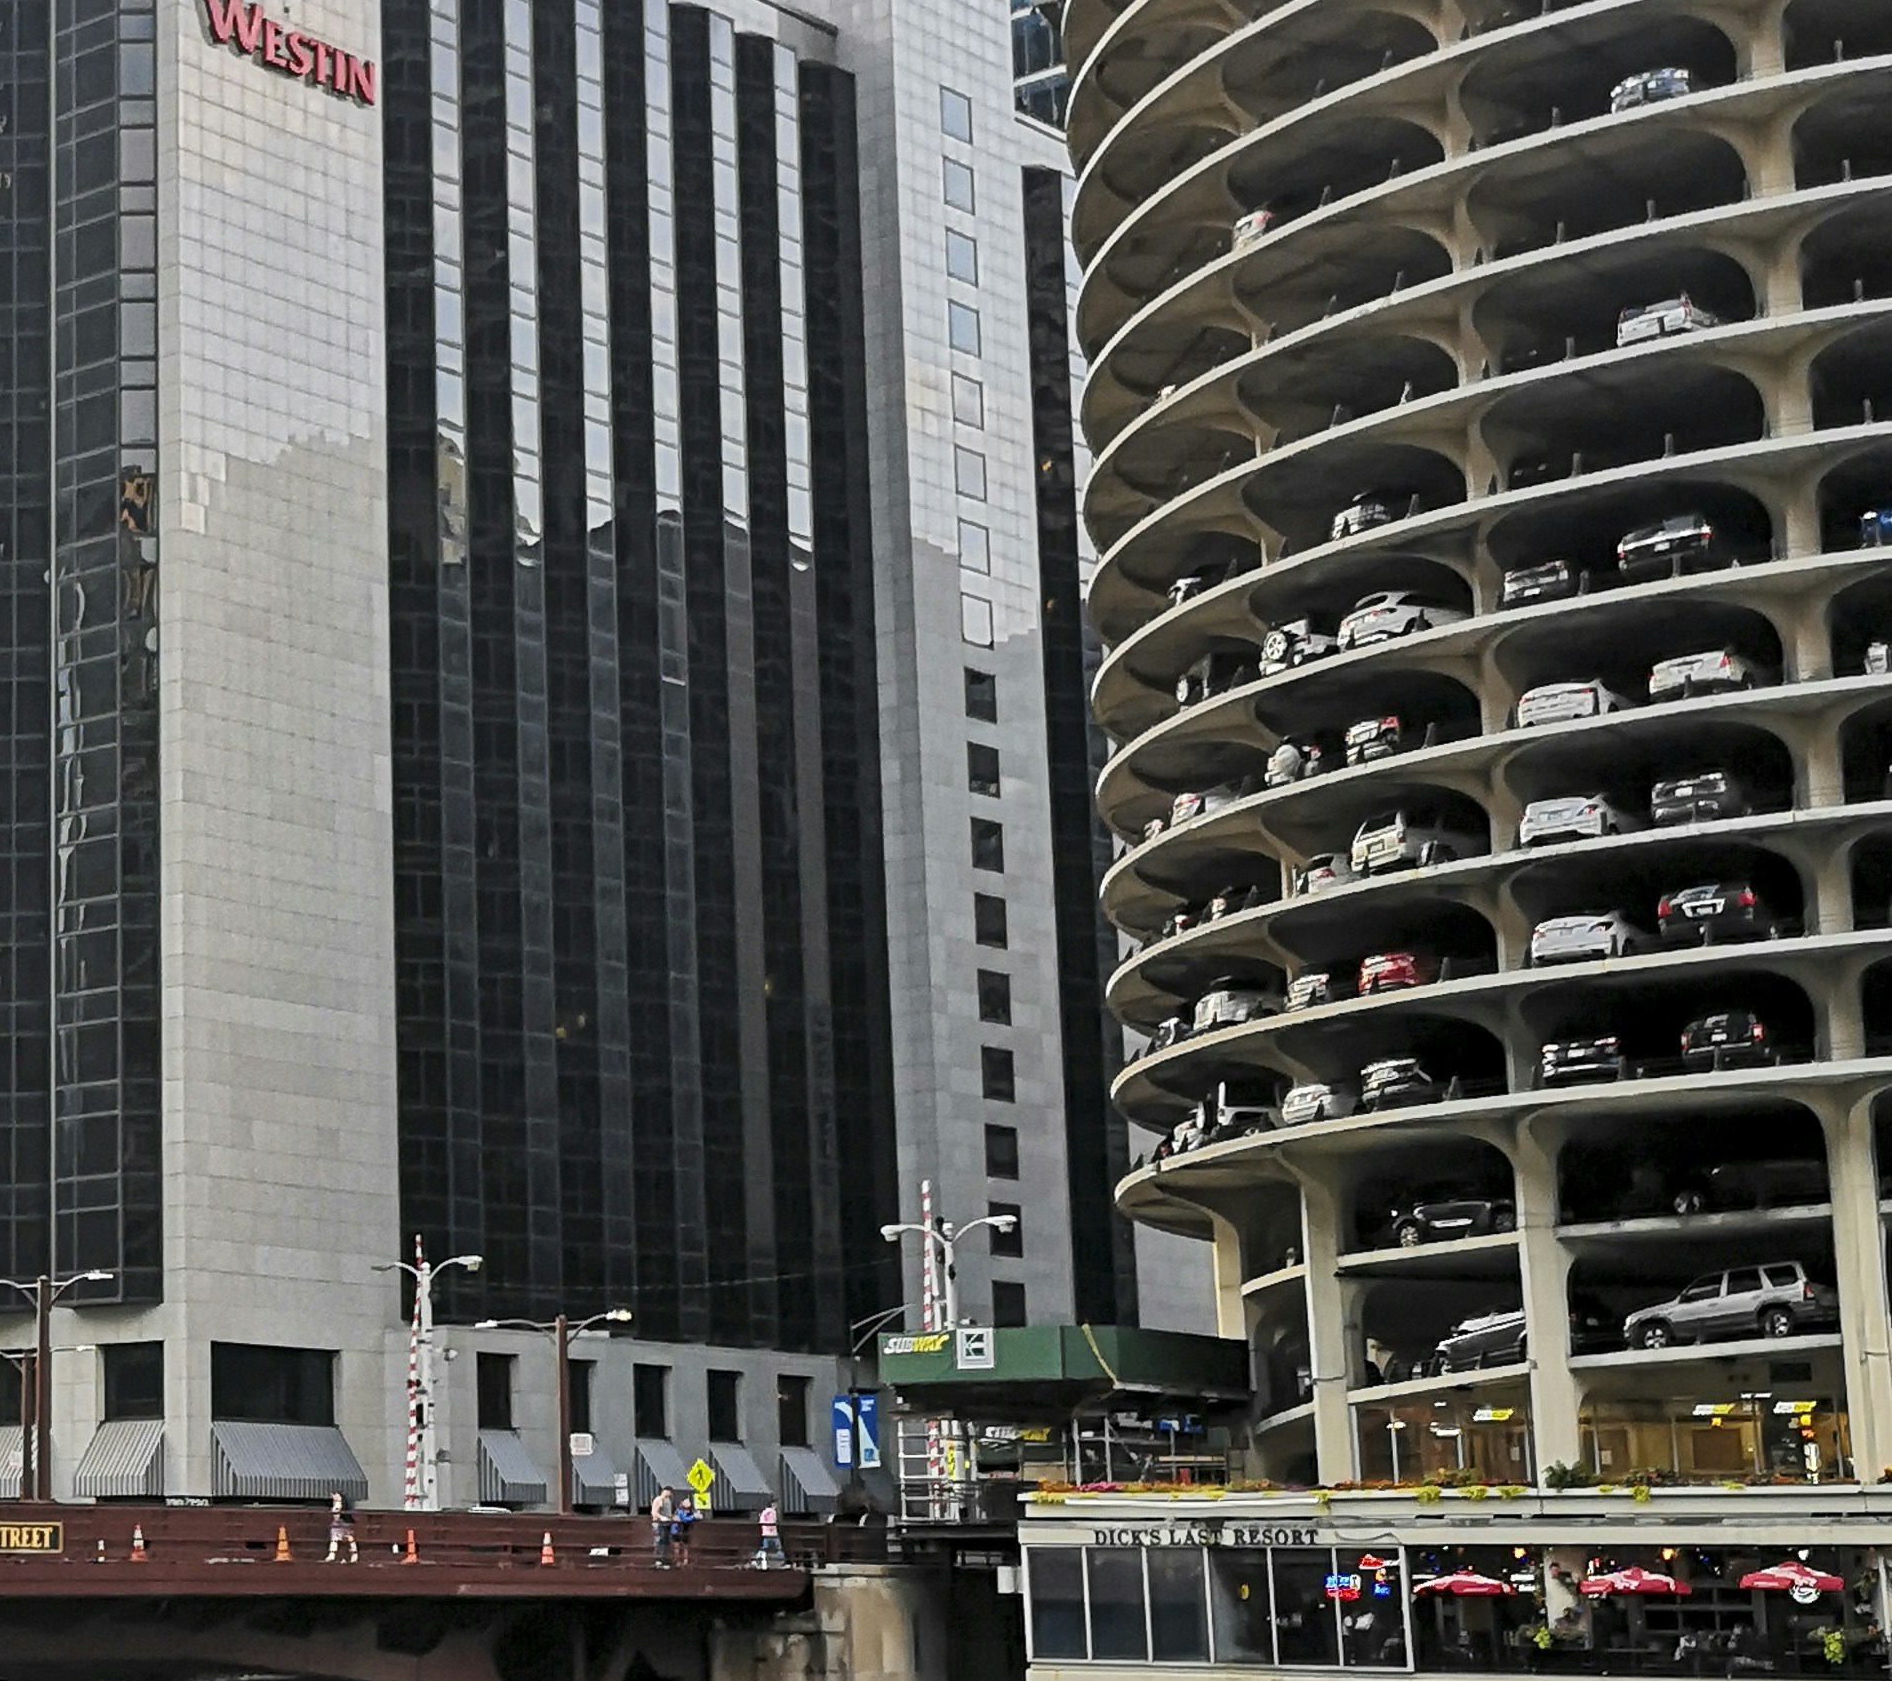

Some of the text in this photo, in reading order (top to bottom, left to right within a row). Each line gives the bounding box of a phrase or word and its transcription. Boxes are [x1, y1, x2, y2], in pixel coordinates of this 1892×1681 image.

[883, 1333, 950, 1354] SUBWAY
[1094, 1527, 1319, 1546] DICK'S LAST RESORT
